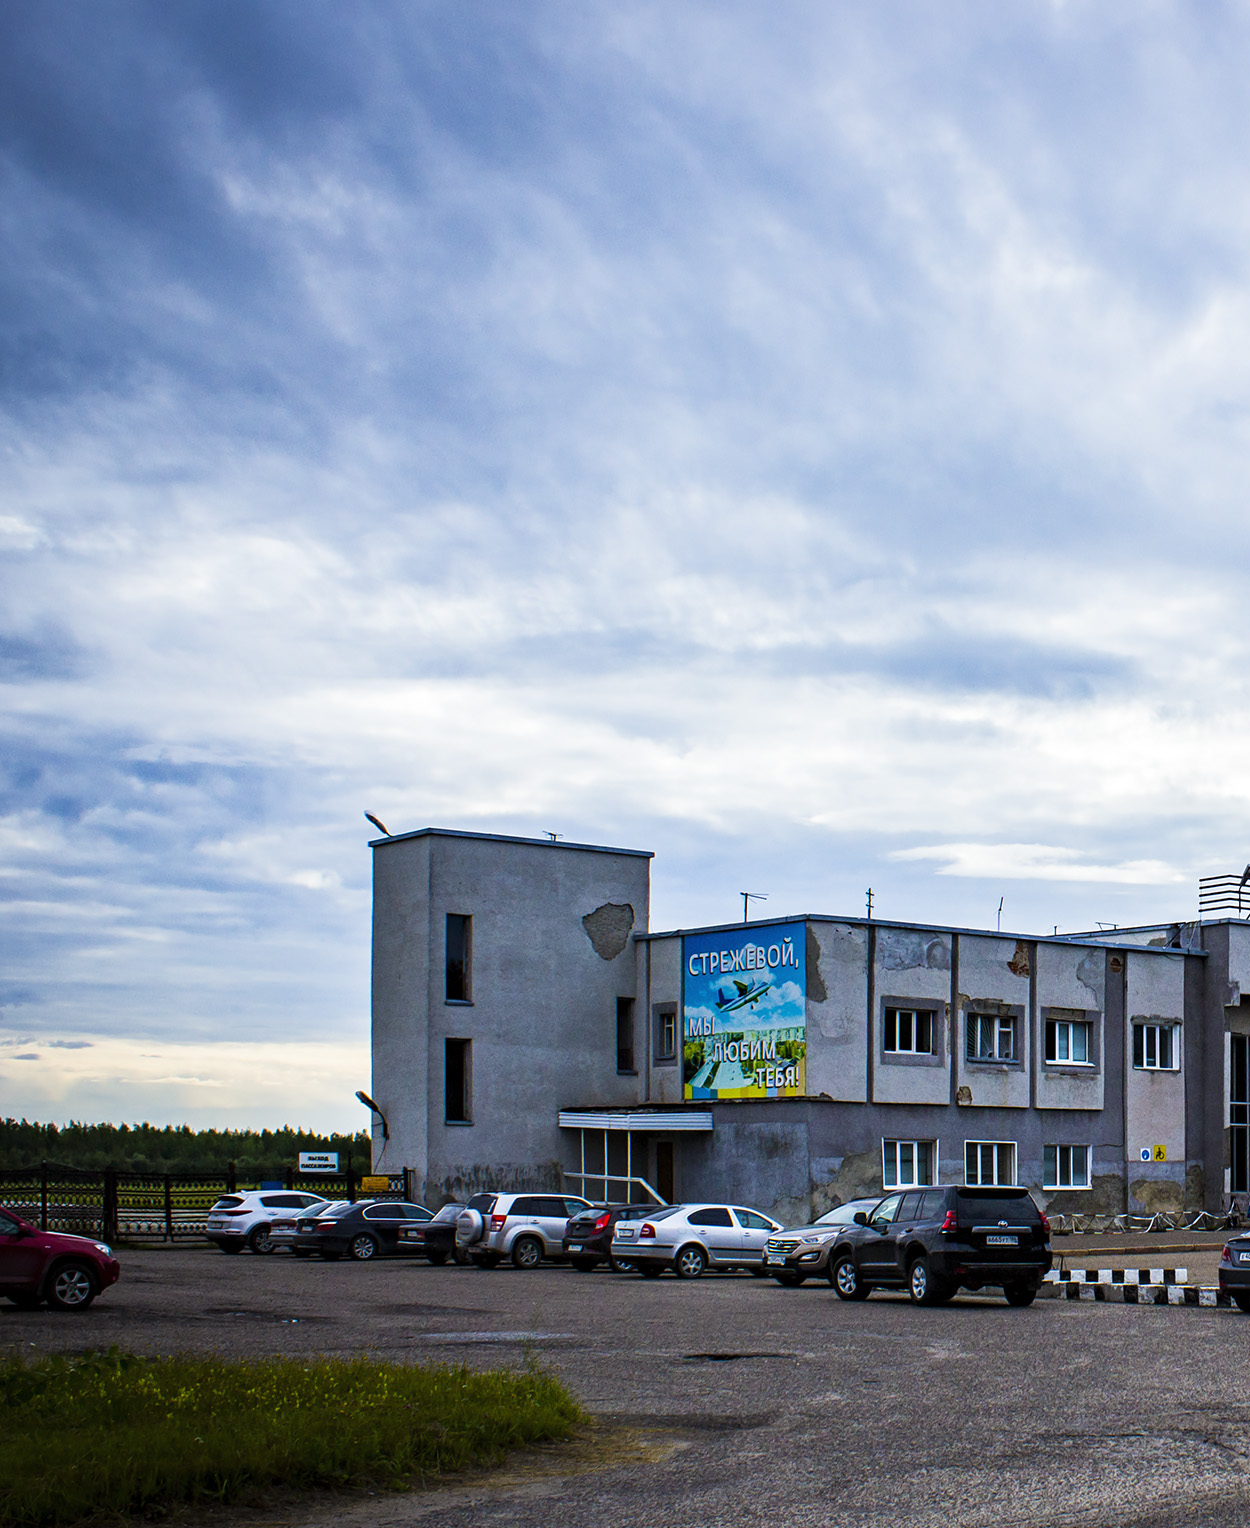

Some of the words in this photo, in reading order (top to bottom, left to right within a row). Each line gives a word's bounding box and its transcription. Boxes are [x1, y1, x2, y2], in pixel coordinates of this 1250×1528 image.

[688, 936, 799, 977] СТРЕЖЕВОЙ,
[688, 1016, 716, 1037] МЫ
[711, 1039, 777, 1063] ЛЮБИМ
[755, 1065, 800, 1089] ТЕБЯ!
